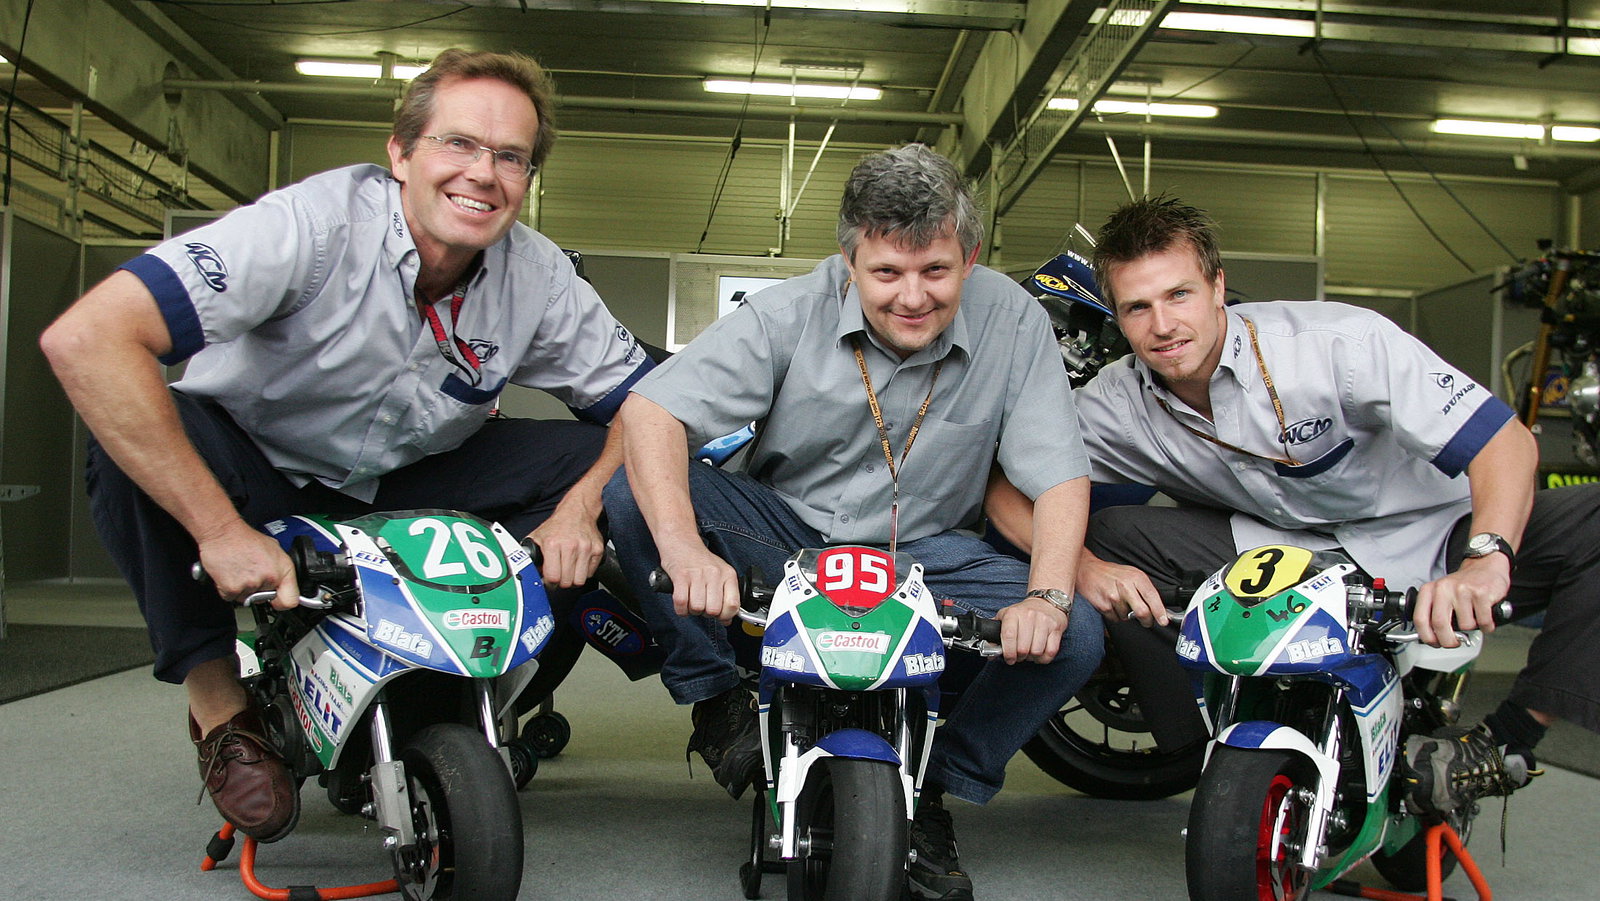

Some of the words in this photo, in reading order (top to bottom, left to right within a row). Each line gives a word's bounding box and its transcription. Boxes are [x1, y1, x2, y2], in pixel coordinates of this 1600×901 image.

[1035, 274, 1070, 291] WCM
[1442, 383, 1476, 415] DUNLOP
[874, 414, 884, 428] 125
[408, 518, 503, 579] 26
[825, 553, 888, 594] 95
[1240, 548, 1285, 595] 3
[461, 611, 503, 626] Castrol
[1266, 594, 1306, 623] 46
[374, 619, 433, 659] Blata
[520, 614, 555, 654] Blata
[596, 619, 629, 647] STM
[834, 635, 880, 649] Castrol
[761, 646, 805, 672] Blata
[1175, 634, 1201, 661] lata
[1285, 636, 1344, 664] Blata
[903, 652, 945, 676] Blata
[330, 665, 353, 706] Blata
[288, 674, 312, 738] Castrol
